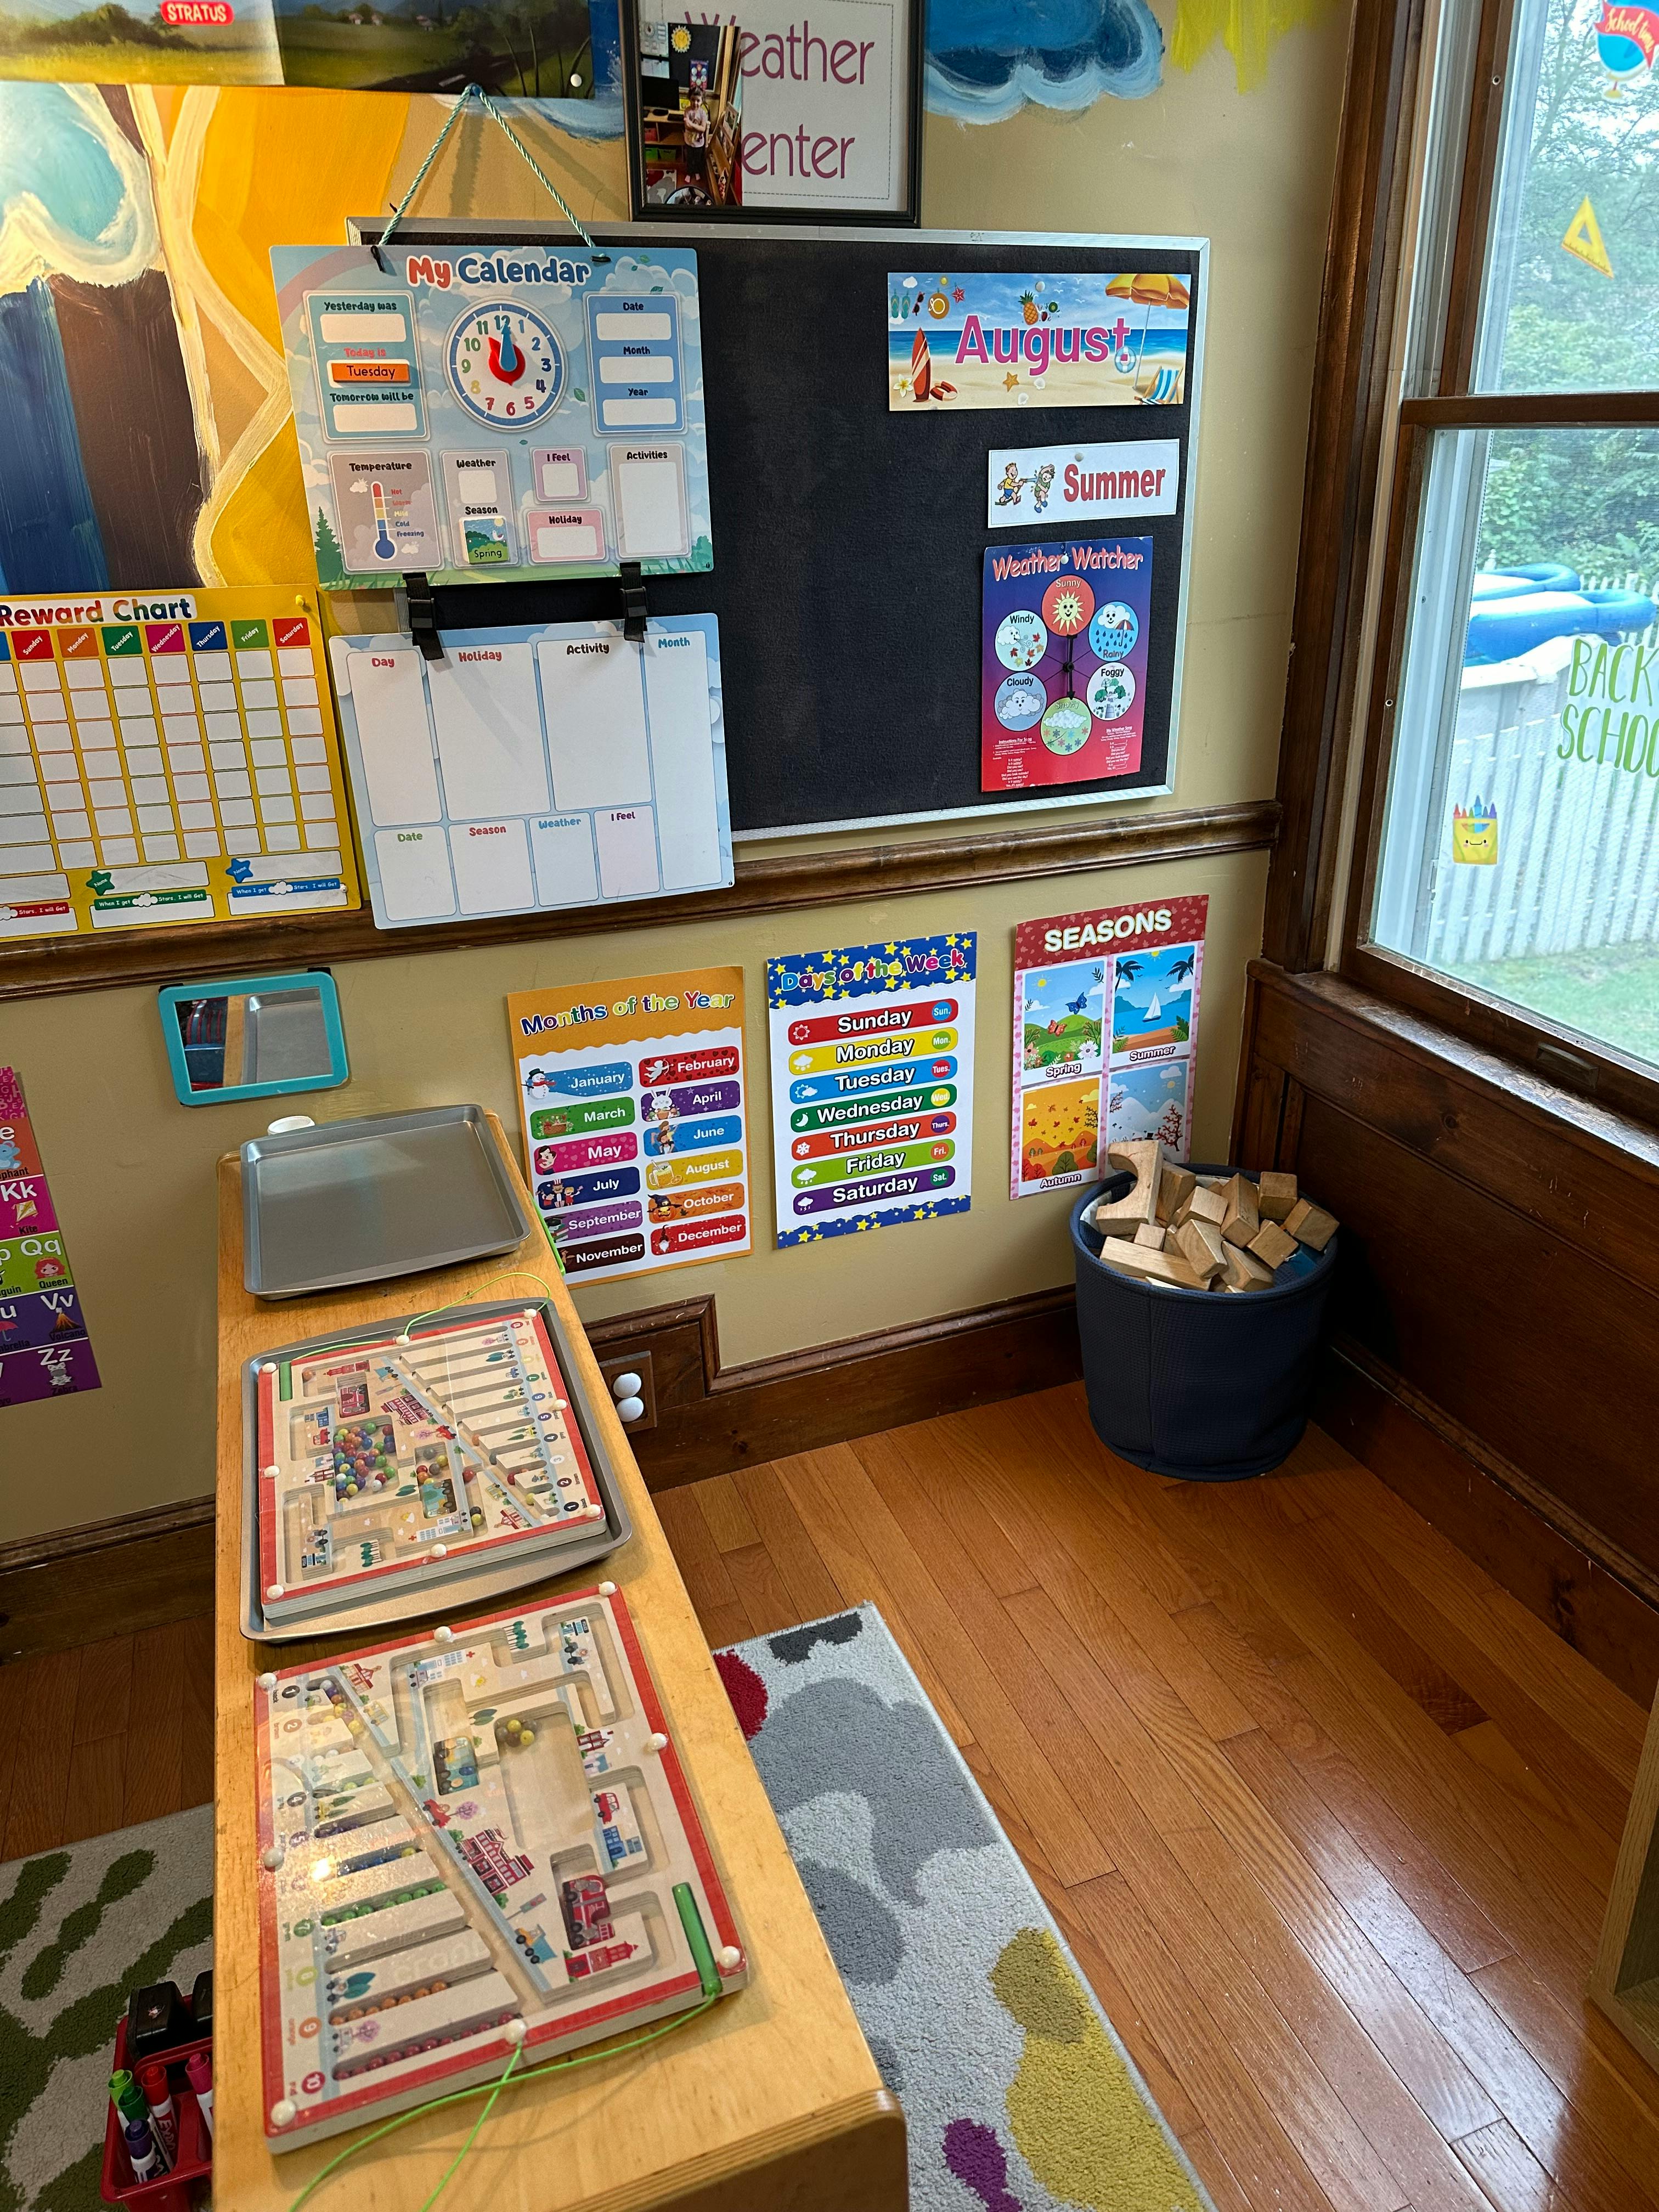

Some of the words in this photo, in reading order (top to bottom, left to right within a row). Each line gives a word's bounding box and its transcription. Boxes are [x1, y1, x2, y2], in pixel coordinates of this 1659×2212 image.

[167, 3, 227, 22] STRATUS
[684, 11, 874, 84] eather
[741, 124, 855, 179] enter
[408, 256, 452, 290] My
[457, 257, 590, 284] Calendar
[324, 301, 375, 312] Yesterday
[377, 302, 397, 311] was
[623, 302, 644, 311] Date
[476, 320, 489, 335] 11
[494, 315, 511, 330] 12
[518, 319, 525, 334] 1
[464, 337, 481, 352] 10
[532, 337, 540, 351] 2
[623, 346, 650, 355] Month
[955, 315, 1130, 376] August
[343, 347, 375, 359] Today
[377, 347, 386, 357] is
[346, 365, 395, 379] Tuesday
[461, 359, 471, 373] 9
[541, 358, 551, 372] 3
[471, 380, 481, 394] 8
[536, 379, 546, 393] 4
[628, 388, 648, 396] Year
[330, 393, 379, 402] Tomorrow
[382, 392, 400, 400] will
[402, 392, 414, 400] be
[486, 397, 494, 410] 7
[524, 396, 534, 409] 5
[506, 402, 516, 416] 6
[552, 453, 571, 461] Feel
[627, 451, 668, 460] Activities
[349, 462, 412, 472] Temperature
[456, 459, 496, 468] Weather
[1063, 464, 1166, 502] Summer
[465, 506, 498, 515] Season
[549, 516, 582, 524] Holiday
[474, 550, 502, 560] Spring
[992, 549, 1063, 582] Weather
[1071, 544, 1143, 573] Watcher
[1056, 579, 1081, 589] Sunny
[0, 600, 104, 627] Reward
[112, 598, 192, 622] Chart
[1009, 614, 1035, 624] Windy
[151, 624, 180, 652] Wednesday
[196, 625, 221, 648] Thursday
[241, 627, 259, 642] Friday
[279, 622, 303, 644] Saturday
[22, 635, 43, 655] Sunday
[67, 632, 89, 653] Monday
[111, 631, 133, 651] Tuesday
[658, 636, 690, 648] Month
[458, 649, 502, 662] Holiday
[566, 642, 610, 656] Activity
[1103, 648, 1124, 660] Rainy
[371, 656, 395, 668] Day
[1101, 667, 1125, 678] Foggy
[1569, 638, 1659, 707] BACK
[1007, 676, 1034, 687] Cloudy
[1054, 700, 1080, 710] Snowy
[538, 817, 582, 829] Weather
[616, 811, 636, 821] Feel
[397, 831, 423, 842] Date
[469, 824, 506, 837] Season
[233, 866, 246, 874] Name
[94, 878, 108, 887] Name
[1044, 909, 1172, 952] SEASONS
[781, 968, 836, 993] Days
[840, 966, 864, 984] of
[866, 959, 902, 979] the
[906, 949, 965, 974] Week
[520, 1004, 607, 1036] Months
[612, 996, 636, 1016] of
[642, 994, 679, 1013] the
[685, 991, 735, 1009] Year
[933, 1007, 951, 1017] Sun.
[838, 1010, 912, 1033] Sunday
[933, 1036, 950, 1045] Mon.
[836, 1039, 913, 1063] Monday
[1129, 1045, 1175, 1061] Summer
[677, 1056, 735, 1073] February
[932, 1064, 950, 1074] Tues.
[1046, 1063, 1081, 1079] Spring
[570, 1072, 625, 1089] January
[834, 1066, 915, 1092] Tuesday
[692, 1091, 722, 1105] April
[931, 1092, 950, 1102] Wed.
[584, 1107, 626, 1123] March
[817, 1095, 922, 1123] Wednesday
[932, 1120, 950, 1130] Thurs.
[693, 1126, 725, 1140] June
[831, 1121, 920, 1149] Thursday
[588, 1144, 622, 1160] May
[934, 1146, 946, 1156] Fri.
[685, 1159, 730, 1176] August
[846, 1152, 906, 1174] Friday
[0, 1167, 29, 1180] phant
[933, 1173, 947, 1182] Sat.
[1040, 1172, 1081, 1189] Autumn
[1, 1181, 37, 1201] Kk
[592, 1178, 619, 1192] July
[833, 1177, 918, 1203] Saturday
[684, 1192, 734, 1210] October
[568, 1208, 642, 1231] September
[19, 1226, 38, 1234] Kite
[678, 1223, 742, 1243] December
[20, 1239, 61, 1256] Qq
[575, 1243, 643, 1263] November
[40, 1278, 68, 1289] Queen
[0, 1286, 22, 1297] guin
[41, 1293, 74, 1310] Vv
[49, 1329, 86, 1341] Volcano
[0, 1339, 30, 1352] brella
[37, 1348, 74, 1365] Zz
[52, 1385, 78, 1395] Zebra
